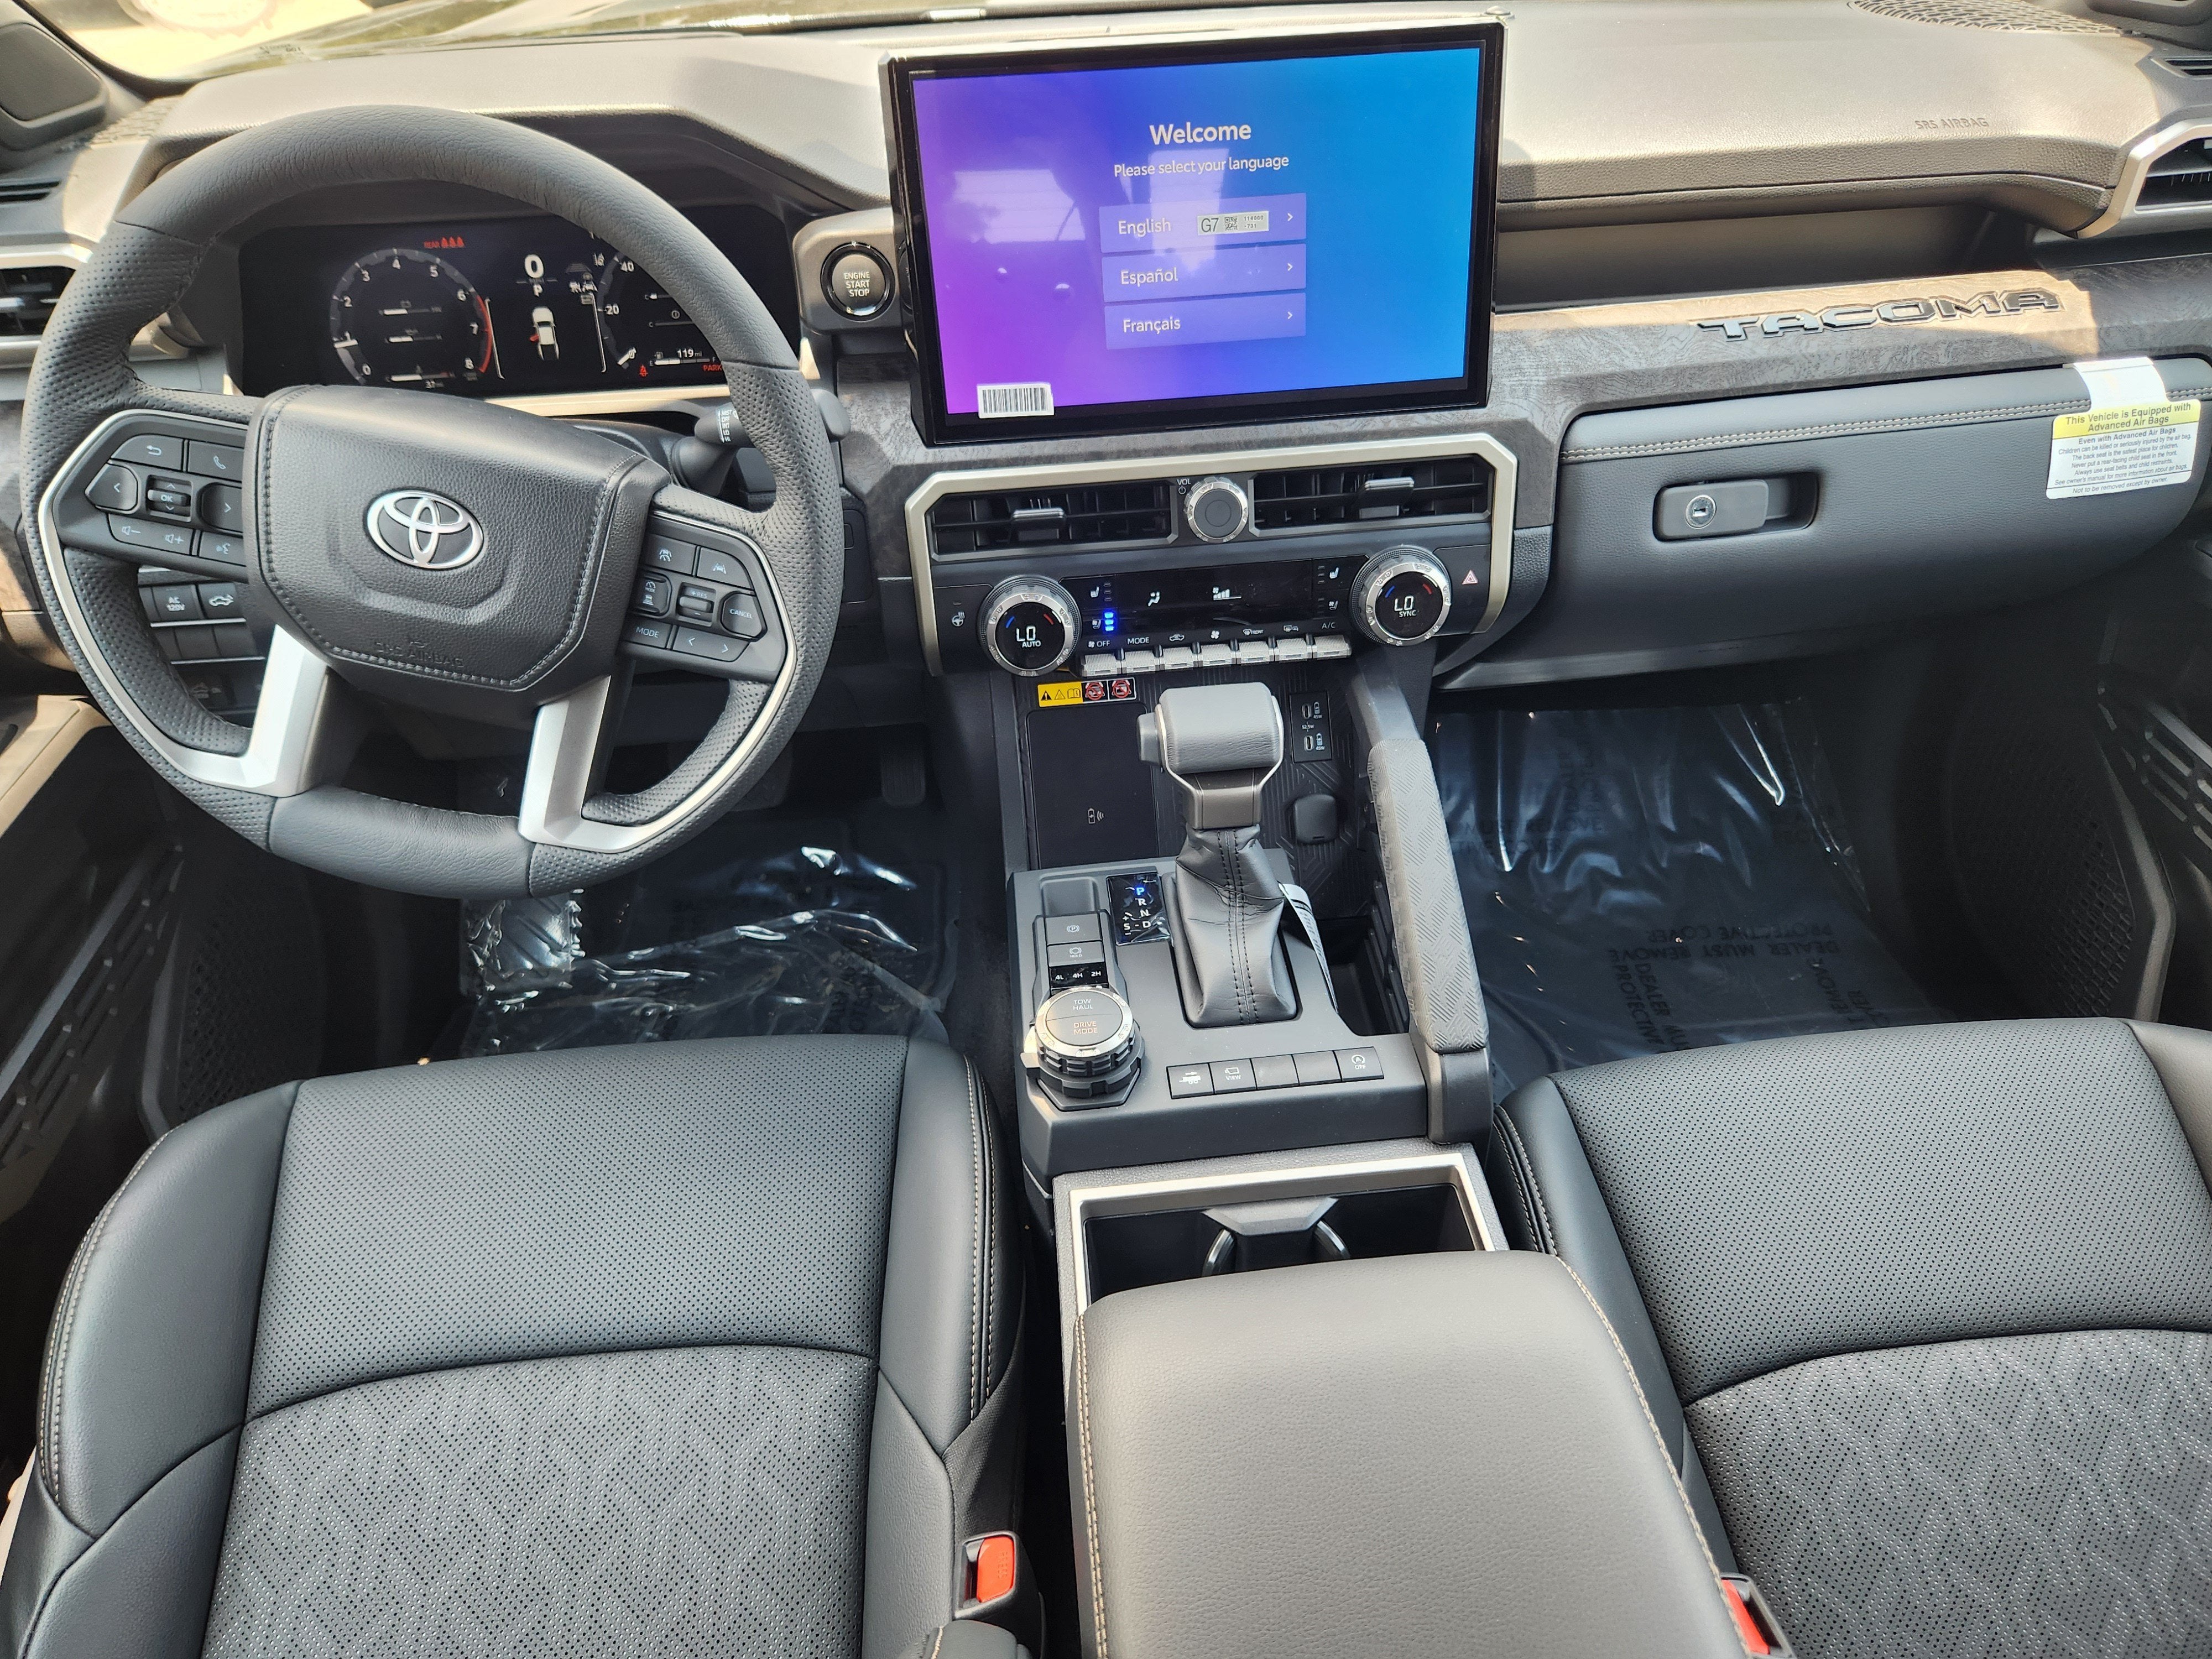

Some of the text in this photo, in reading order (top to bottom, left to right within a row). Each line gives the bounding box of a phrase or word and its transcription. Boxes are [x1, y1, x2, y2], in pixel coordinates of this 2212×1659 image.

[1914, 118, 1989, 129] SRS AIRBAG
[1149, 122, 1251, 145] Welcome
[1114, 156, 1289, 177] Please select your language
[1118, 218, 1171, 237] English
[1201, 217, 1219, 232] G7
[620, 260, 635, 273] 40
[846, 280, 870, 289] START
[1120, 267, 1178, 287] Español
[849, 289, 870, 297] STOP
[606, 303, 620, 315] 20
[1693, 288, 2063, 340] TACOMA
[1123, 316, 1181, 334] Français
[677, 347, 694, 358] 119
[2065, 416, 2085, 425] This
[2088, 412, 2119, 422] Vehicle
[2132, 405, 2172, 418] Equipped
[2174, 403, 2190, 411] with
[2088, 419, 2131, 431] Advanced
[2148, 416, 2169, 425] Bags
[2113, 431, 2147, 440] Advanced
[1394, 596, 1414, 612] LO
[729, 609, 753, 619] CANCEL
[636, 626, 659, 638] MODE
[1016, 625, 1036, 642] LO
[1127, 637, 1150, 645] MODE
